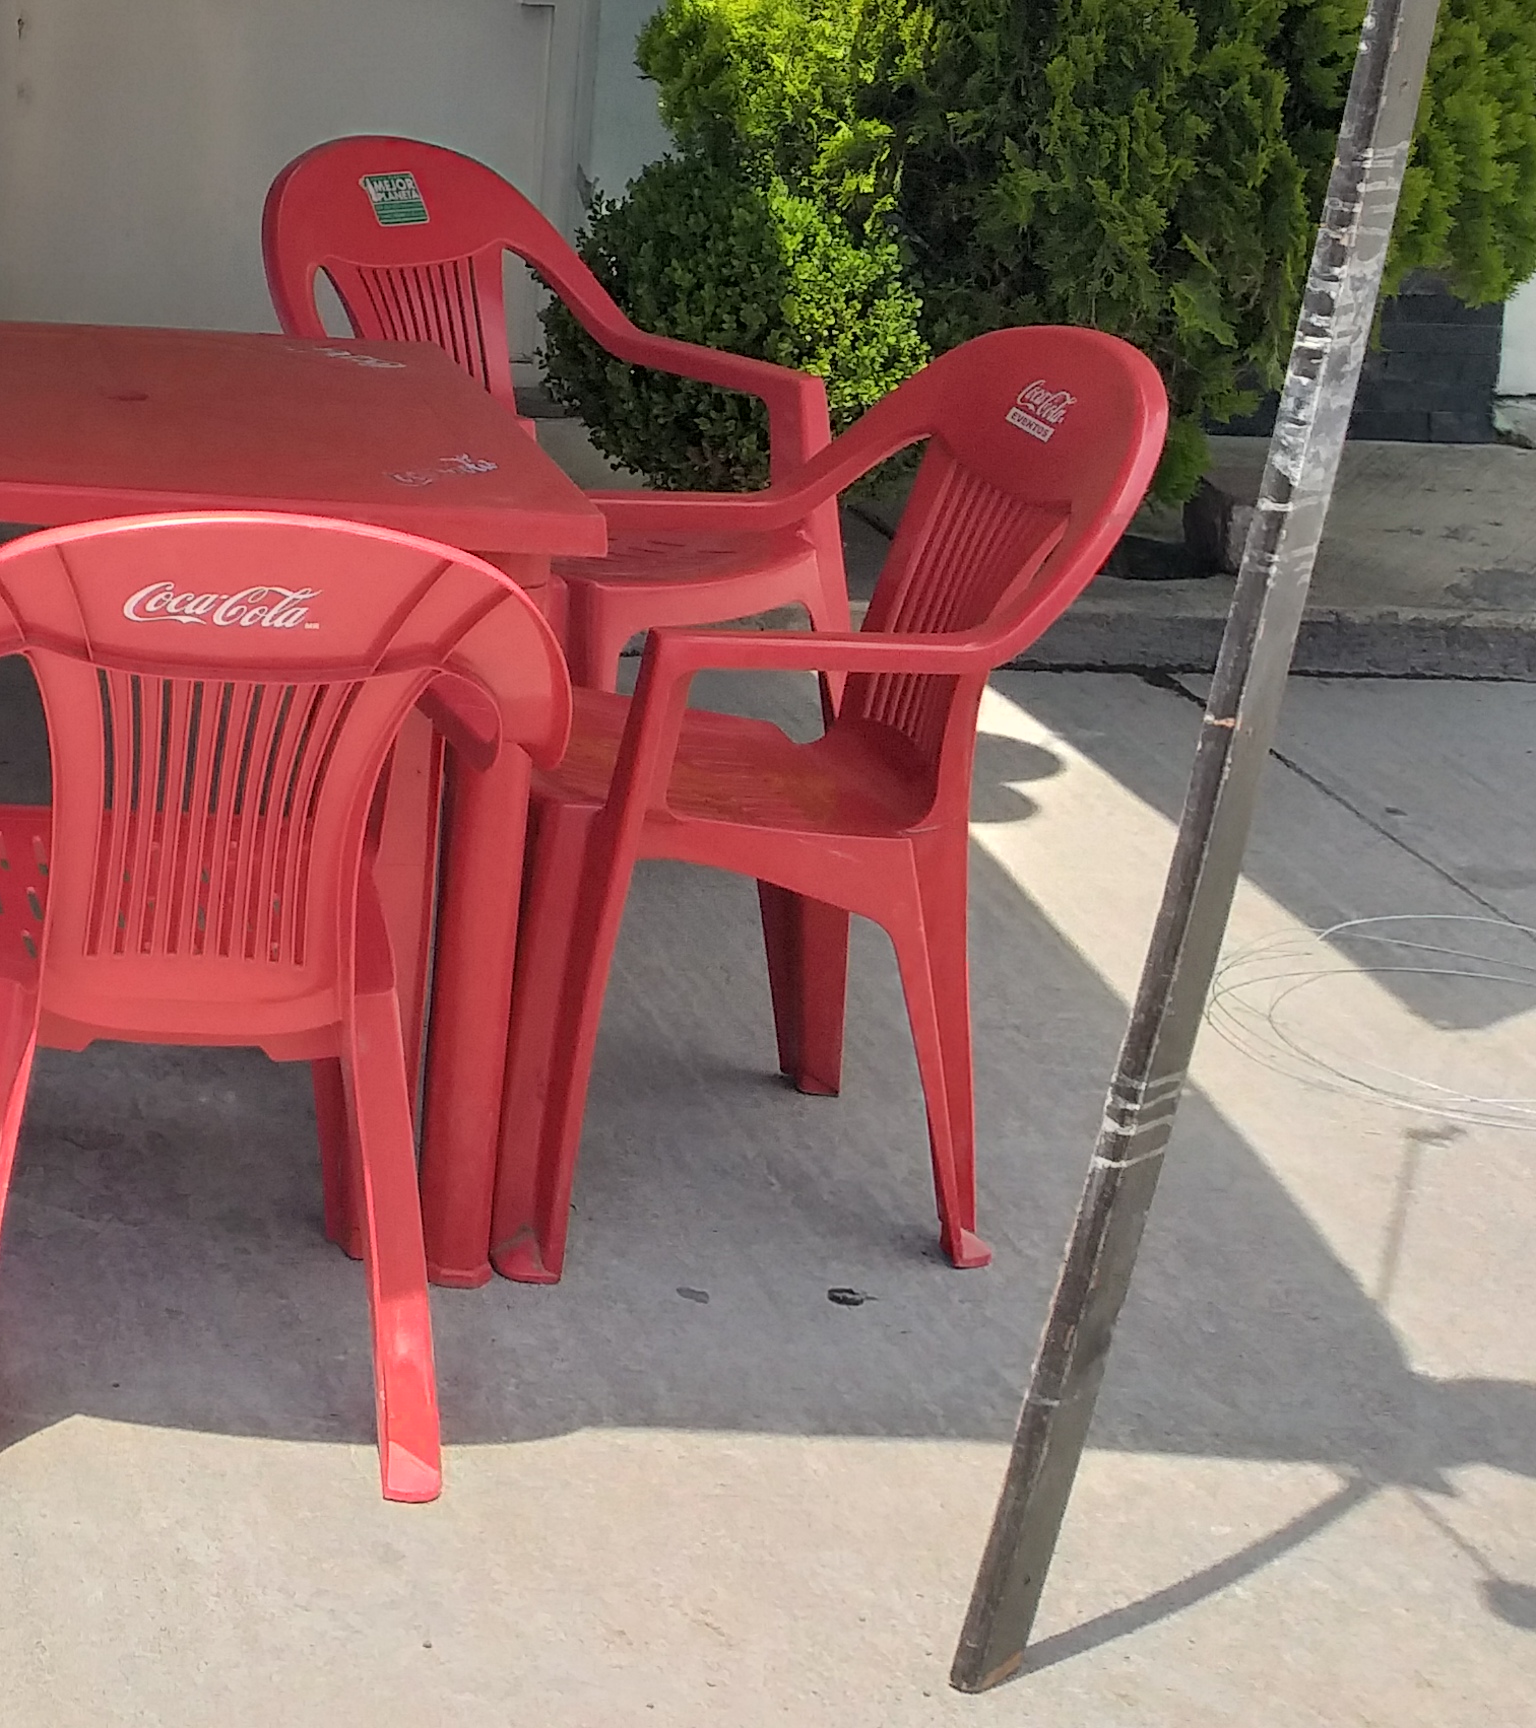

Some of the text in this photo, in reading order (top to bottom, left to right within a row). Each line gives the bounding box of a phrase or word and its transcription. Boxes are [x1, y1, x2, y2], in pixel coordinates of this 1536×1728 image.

[373, 177, 416, 192] MEJOR
[1016, 379, 1077, 425] Coca-Cola
[1011, 411, 1050, 438] EVENTOS
[123, 581, 323, 629] Coca-Cola
